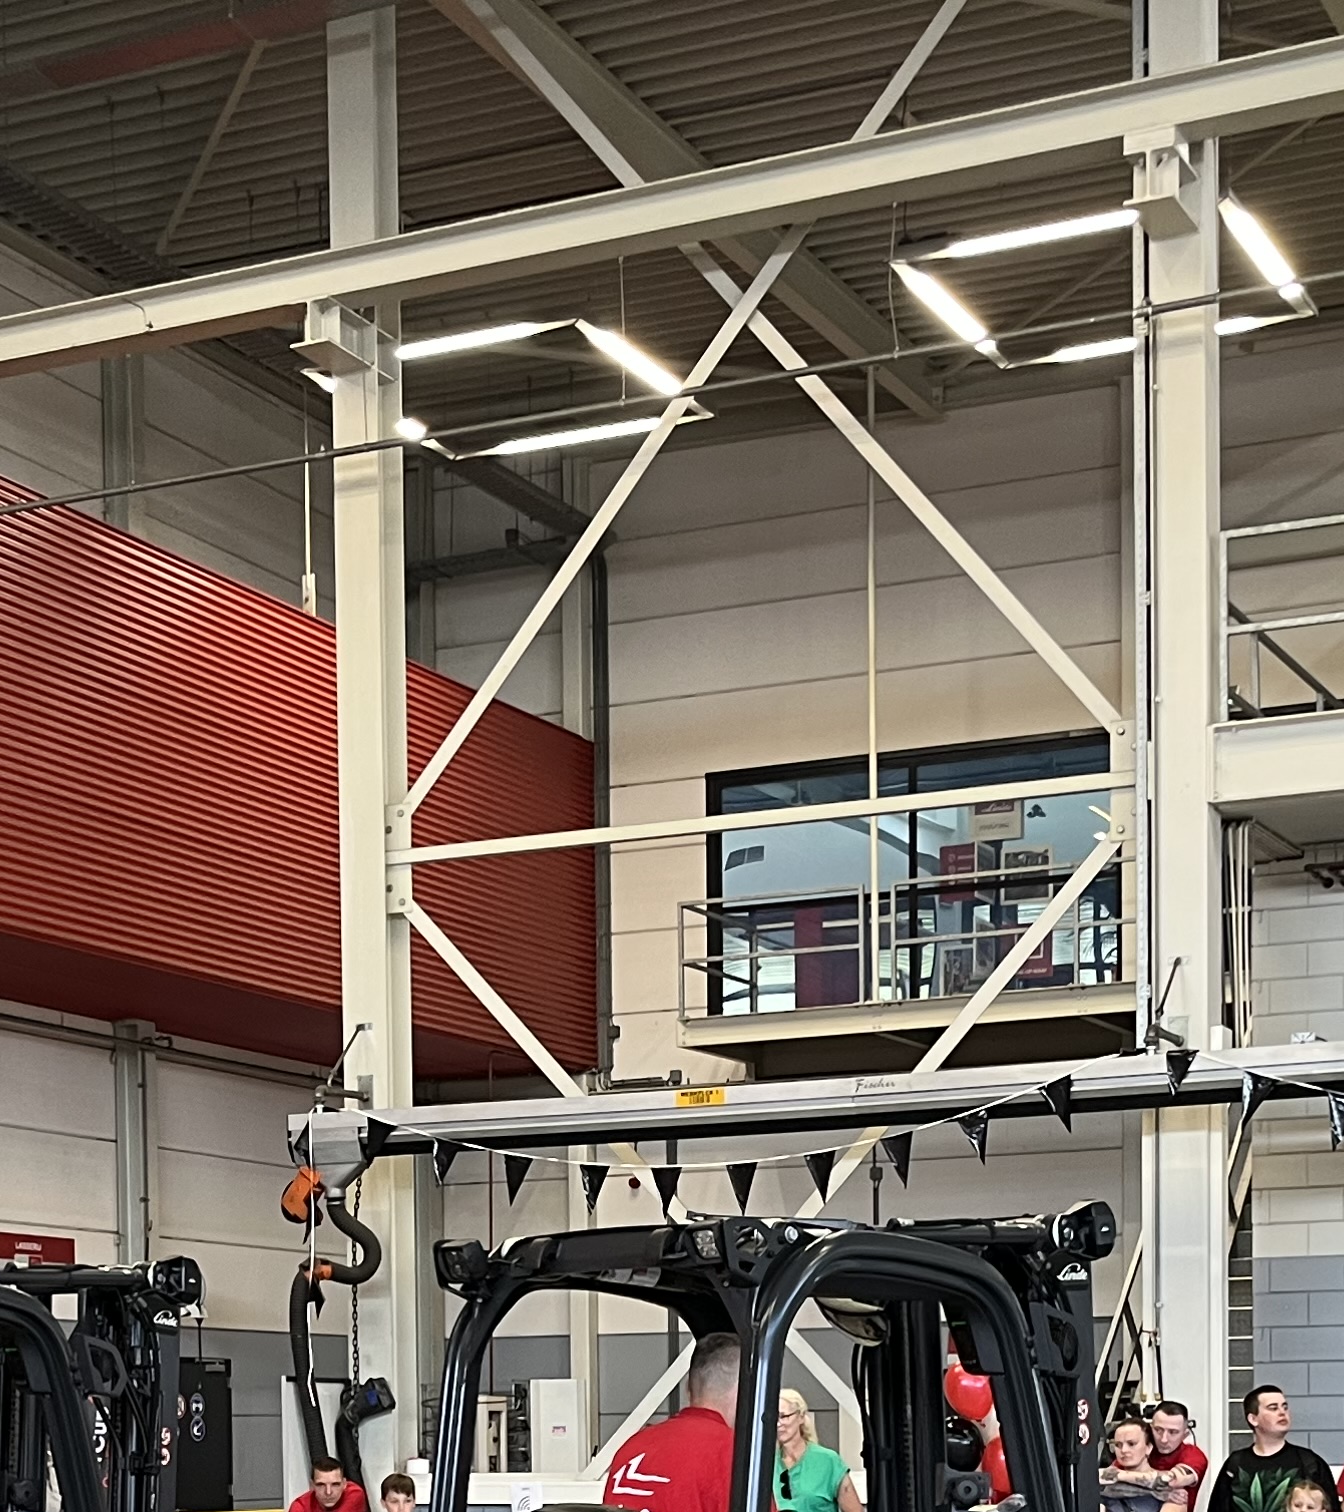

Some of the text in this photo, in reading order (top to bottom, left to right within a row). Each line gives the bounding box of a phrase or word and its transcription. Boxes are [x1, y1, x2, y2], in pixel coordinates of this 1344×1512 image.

[854, 1078, 896, 1093] Fischer
[1056, 1262, 1088, 1281] Linde
[153, 1309, 178, 1328] Linde
